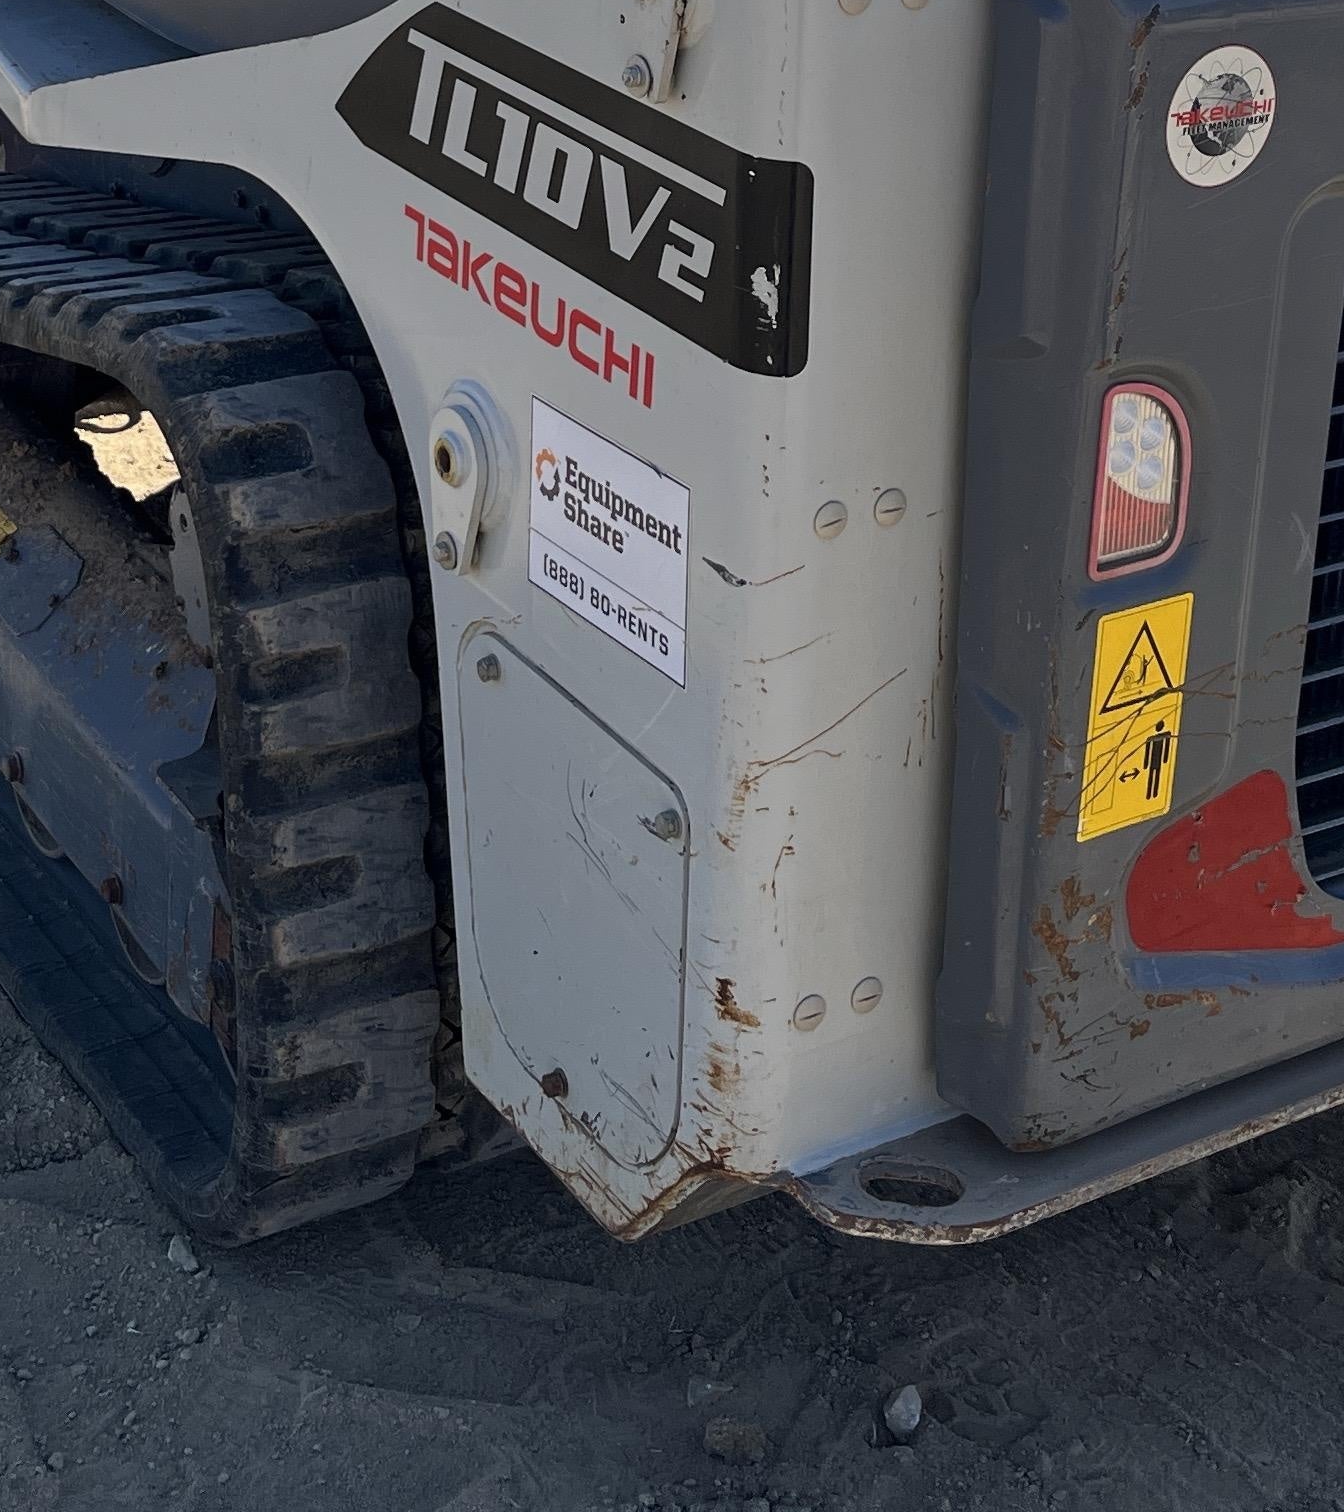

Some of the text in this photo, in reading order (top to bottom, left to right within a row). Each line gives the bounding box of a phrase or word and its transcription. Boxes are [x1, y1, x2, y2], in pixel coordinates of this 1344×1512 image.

[563, 494, 624, 554] Share
[564, 455, 682, 556] Equipment
[543, 552, 670, 656] (888) 80-RENTS
